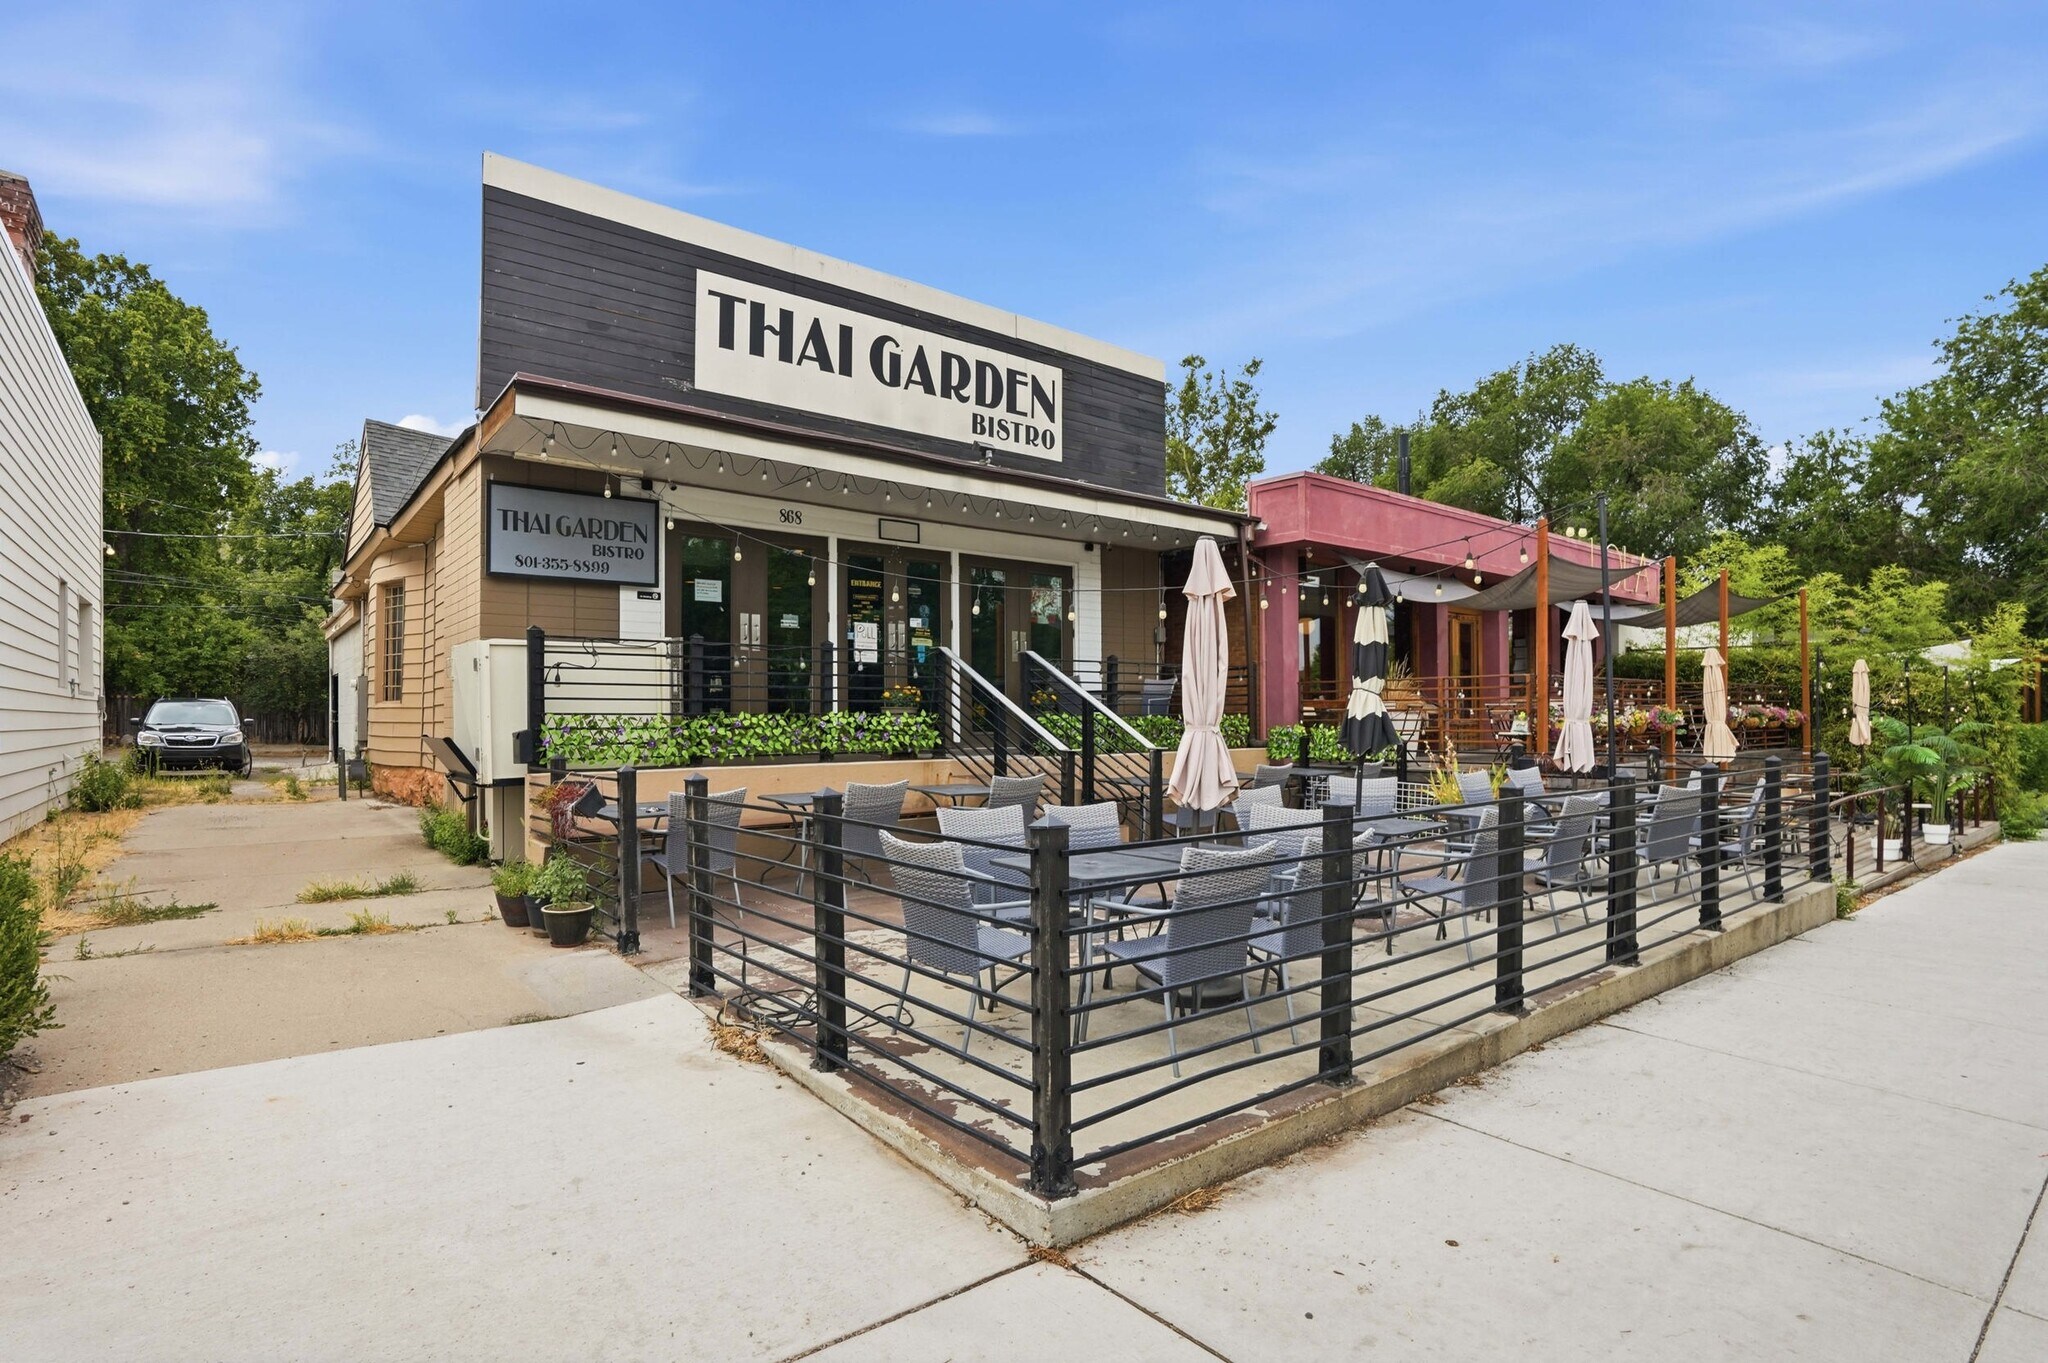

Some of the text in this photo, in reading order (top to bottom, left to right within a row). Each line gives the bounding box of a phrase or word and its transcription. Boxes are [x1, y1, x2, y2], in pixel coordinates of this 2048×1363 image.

[708, 289, 1055, 424] THAI GARDEN
[971, 412, 1055, 450] BISTRO
[496, 508, 648, 544] THAI GARDEN
[779, 508, 802, 525] 868
[592, 544, 645, 560] BISTRO
[514, 554, 610, 575] 801-355-8899
[851, 579, 882, 589] ENTRANCE
